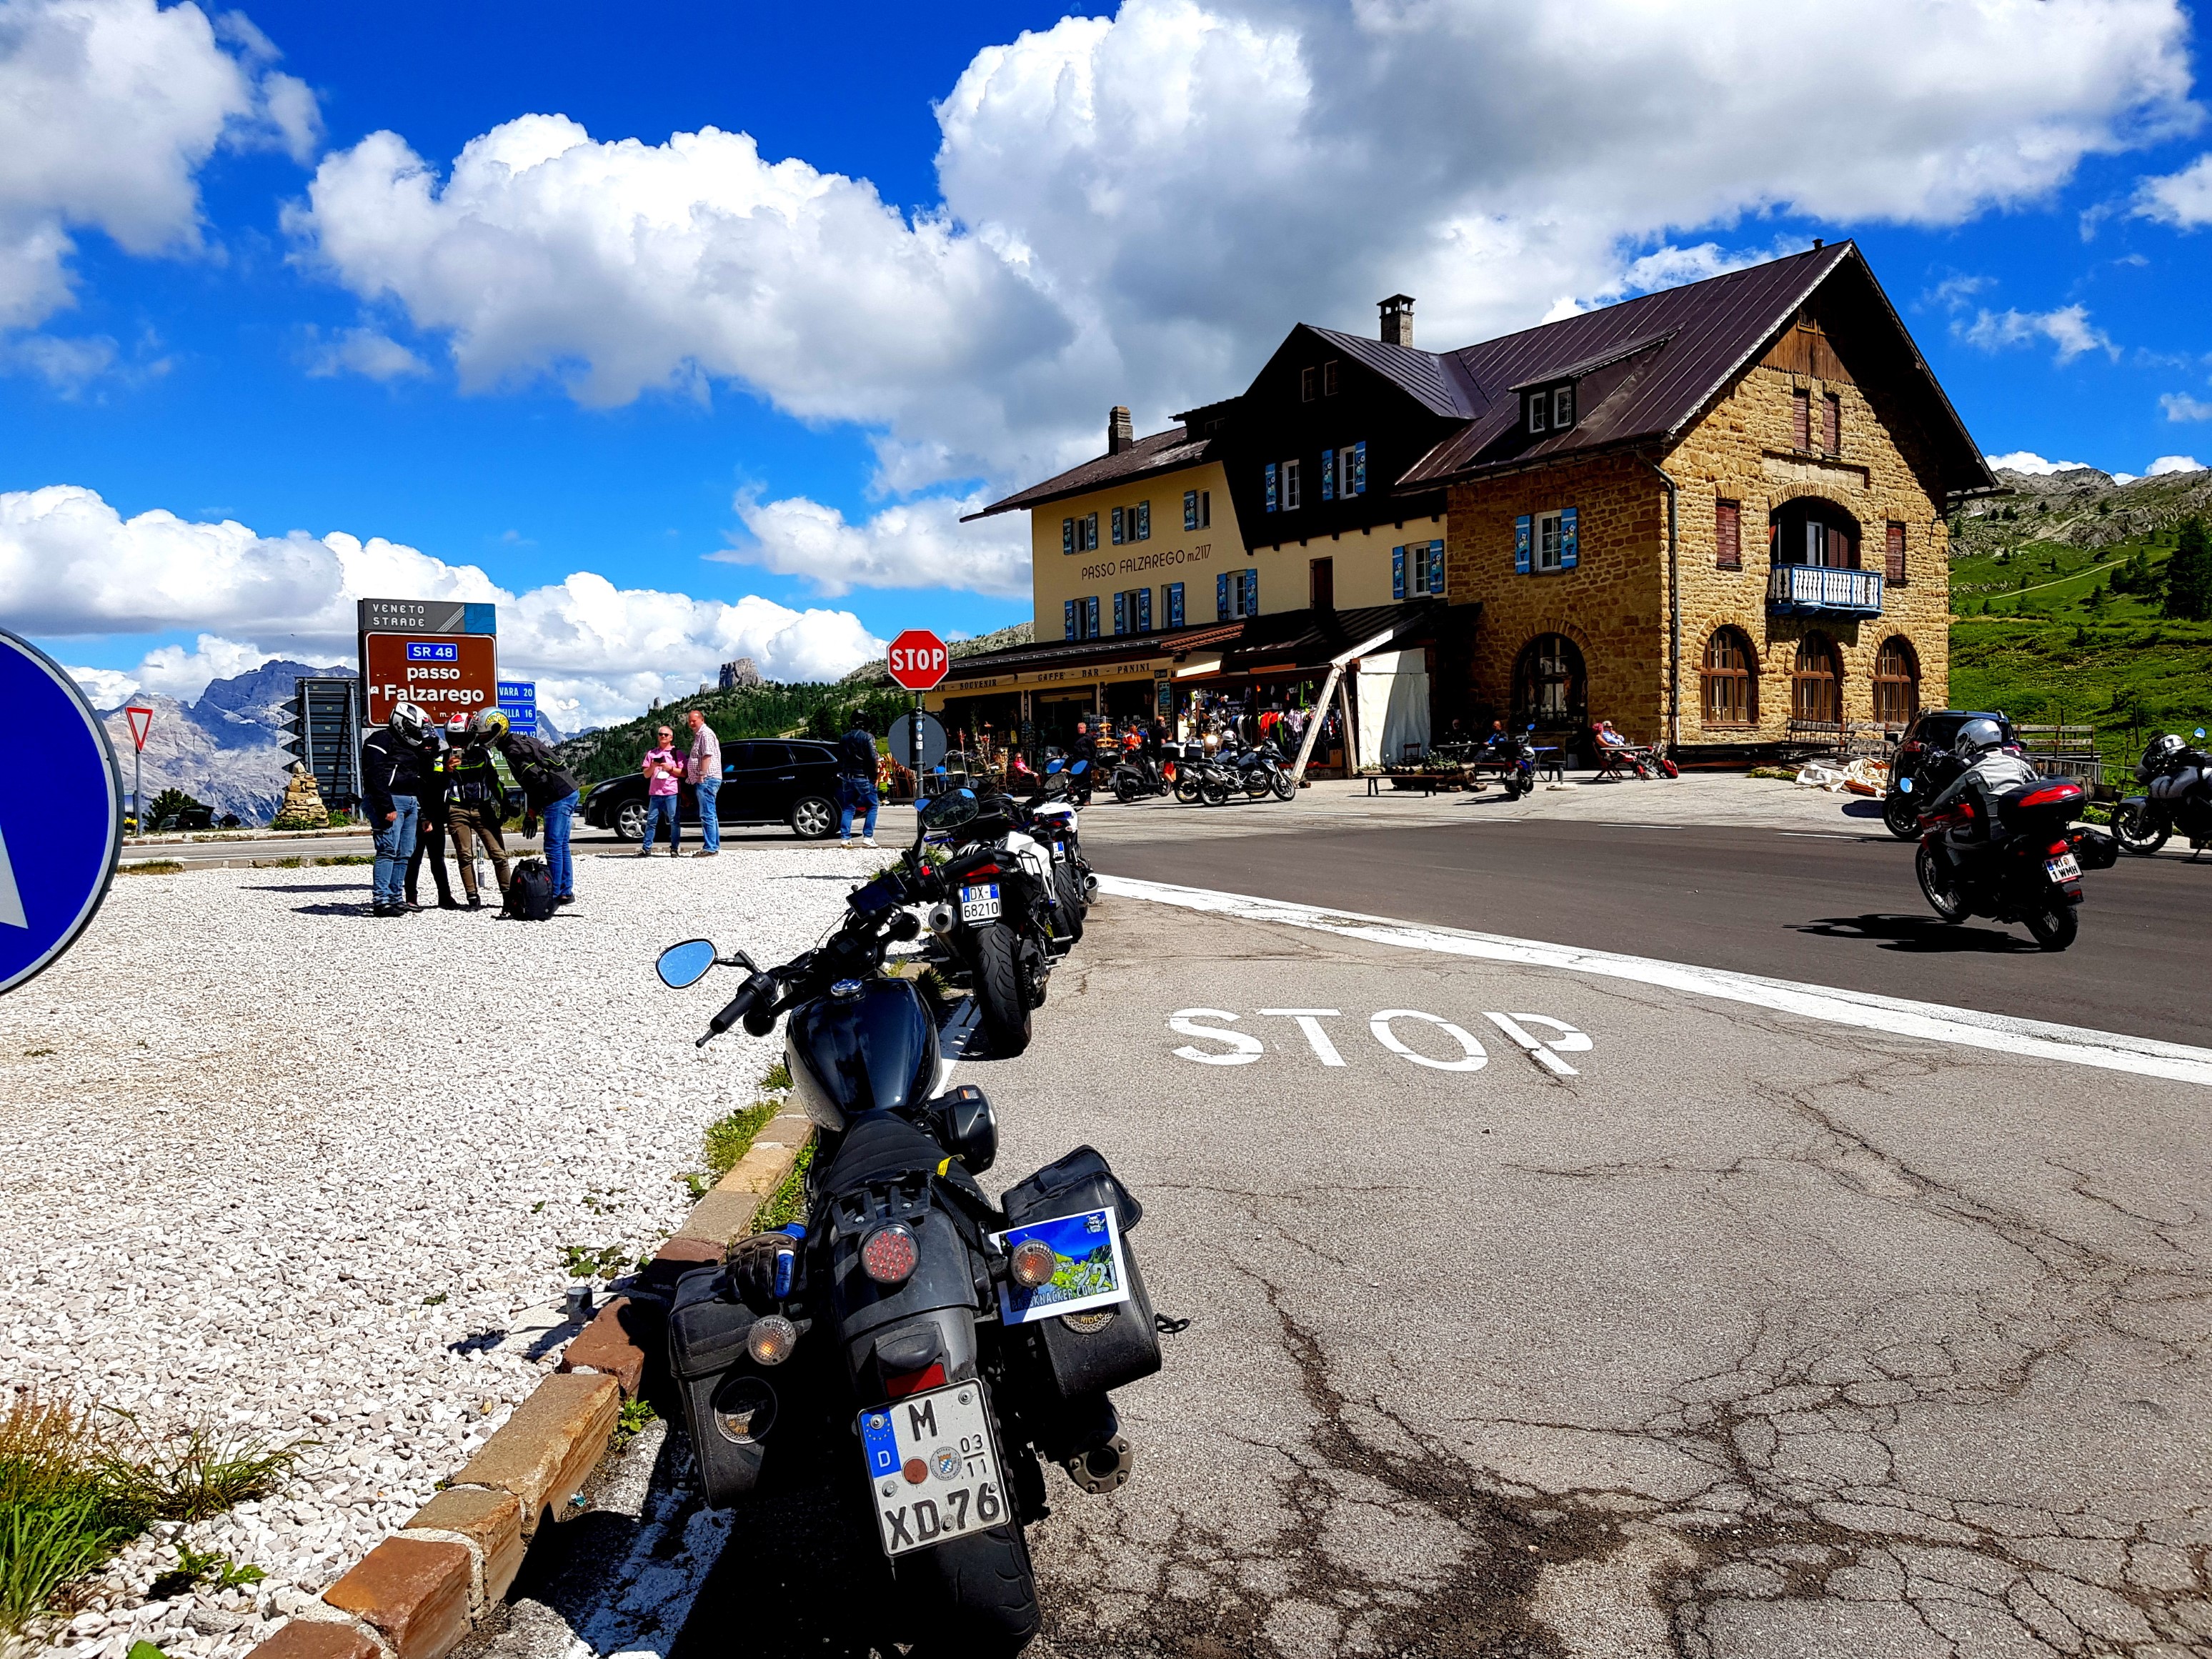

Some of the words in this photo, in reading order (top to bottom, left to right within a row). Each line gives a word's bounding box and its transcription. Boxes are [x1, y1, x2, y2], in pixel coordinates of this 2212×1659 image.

[1082, 562, 1116, 581] PASSO
[1120, 549, 1185, 574] FALZAREGO
[372, 604, 424, 614] VENETO
[373, 617, 425, 627] STRADE
[413, 647, 431, 657] SR
[435, 647, 453, 657] 48
[892, 648, 945, 671] STOP
[407, 667, 461, 682] passo
[1082, 668, 1099, 677] BAR
[1117, 663, 1150, 674] PANINI
[499, 686, 519, 697] VARA
[523, 687, 533, 697] 20
[960, 679, 997, 690] SOUVENIR
[384, 684, 484, 705] Falzarego
[524, 709, 533, 718] 16
[2052, 870, 2058, 880] 1
[2058, 865, 2078, 877] WMH
[970, 887, 984, 900] DX
[964, 902, 999, 918] 68210
[1169, 1007, 1593, 1076] STOP
[1080, 1312, 1104, 1324] RIDER
[908, 1399, 938, 1441] M
[960, 1434, 983, 1453] 03
[877, 1450, 891, 1468] D
[967, 1458, 987, 1478] 11
[885, 1499, 941, 1550] XD
[947, 1483, 1000, 1530] 76
